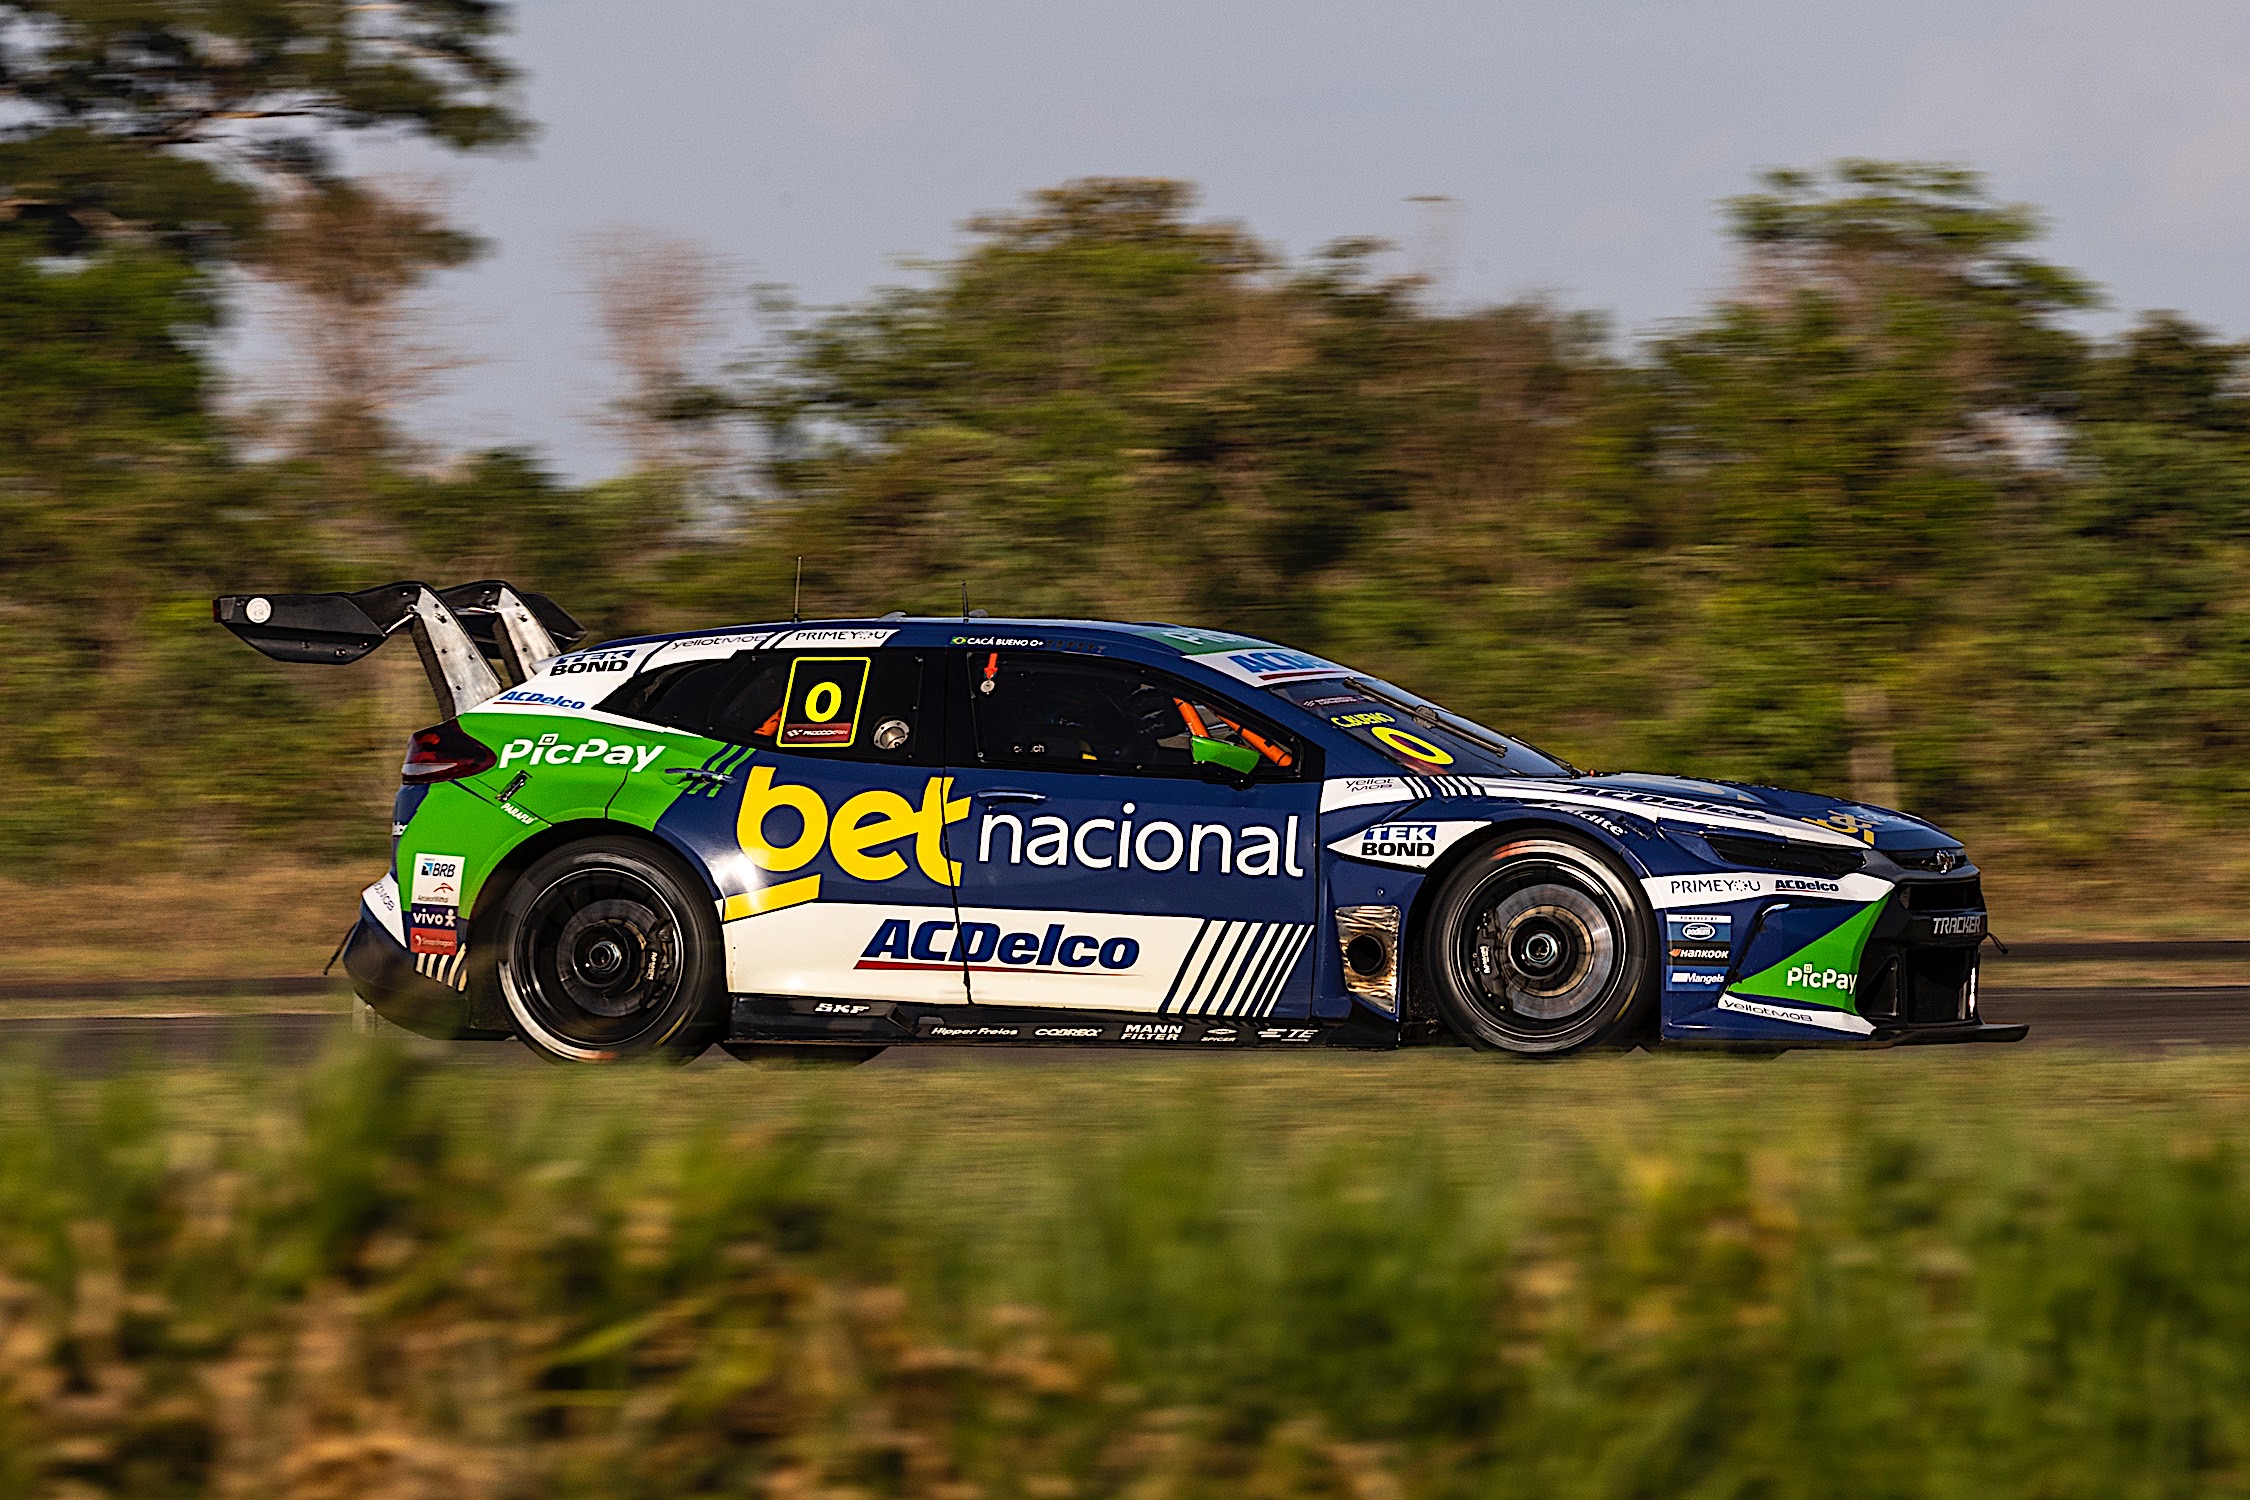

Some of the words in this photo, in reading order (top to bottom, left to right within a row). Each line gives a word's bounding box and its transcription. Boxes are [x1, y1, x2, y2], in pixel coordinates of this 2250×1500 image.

[967, 636, 995, 645] CACÁ
[996, 638, 1028, 646] BUENO
[550, 659, 629, 677] BOND
[499, 691, 586, 710] ACDelco
[805, 681, 842, 723] 0
[498, 733, 667, 773] PicPay
[1371, 726, 1454, 765] 0
[736, 766, 971, 887] bet
[978, 802, 1304, 877] nacional
[1367, 825, 1437, 841] TEK
[1361, 842, 1435, 858] BOND
[433, 862, 456, 878] BRB
[1671, 879, 1761, 894] PRIMEYOU
[1775, 879, 1840, 893] ACDelco
[412, 907, 444, 925] vivo
[1932, 915, 1981, 935] TRACKER
[861, 918, 1141, 971] ACDelco
[1687, 972, 1725, 985] Mangels
[1787, 963, 1857, 995] PicPay
[814, 1002, 870, 1014] SKF
[1120, 1033, 1179, 1041] FILTER
[1125, 1024, 1183, 1035] MANN
[1287, 1029, 1319, 1039] TE
